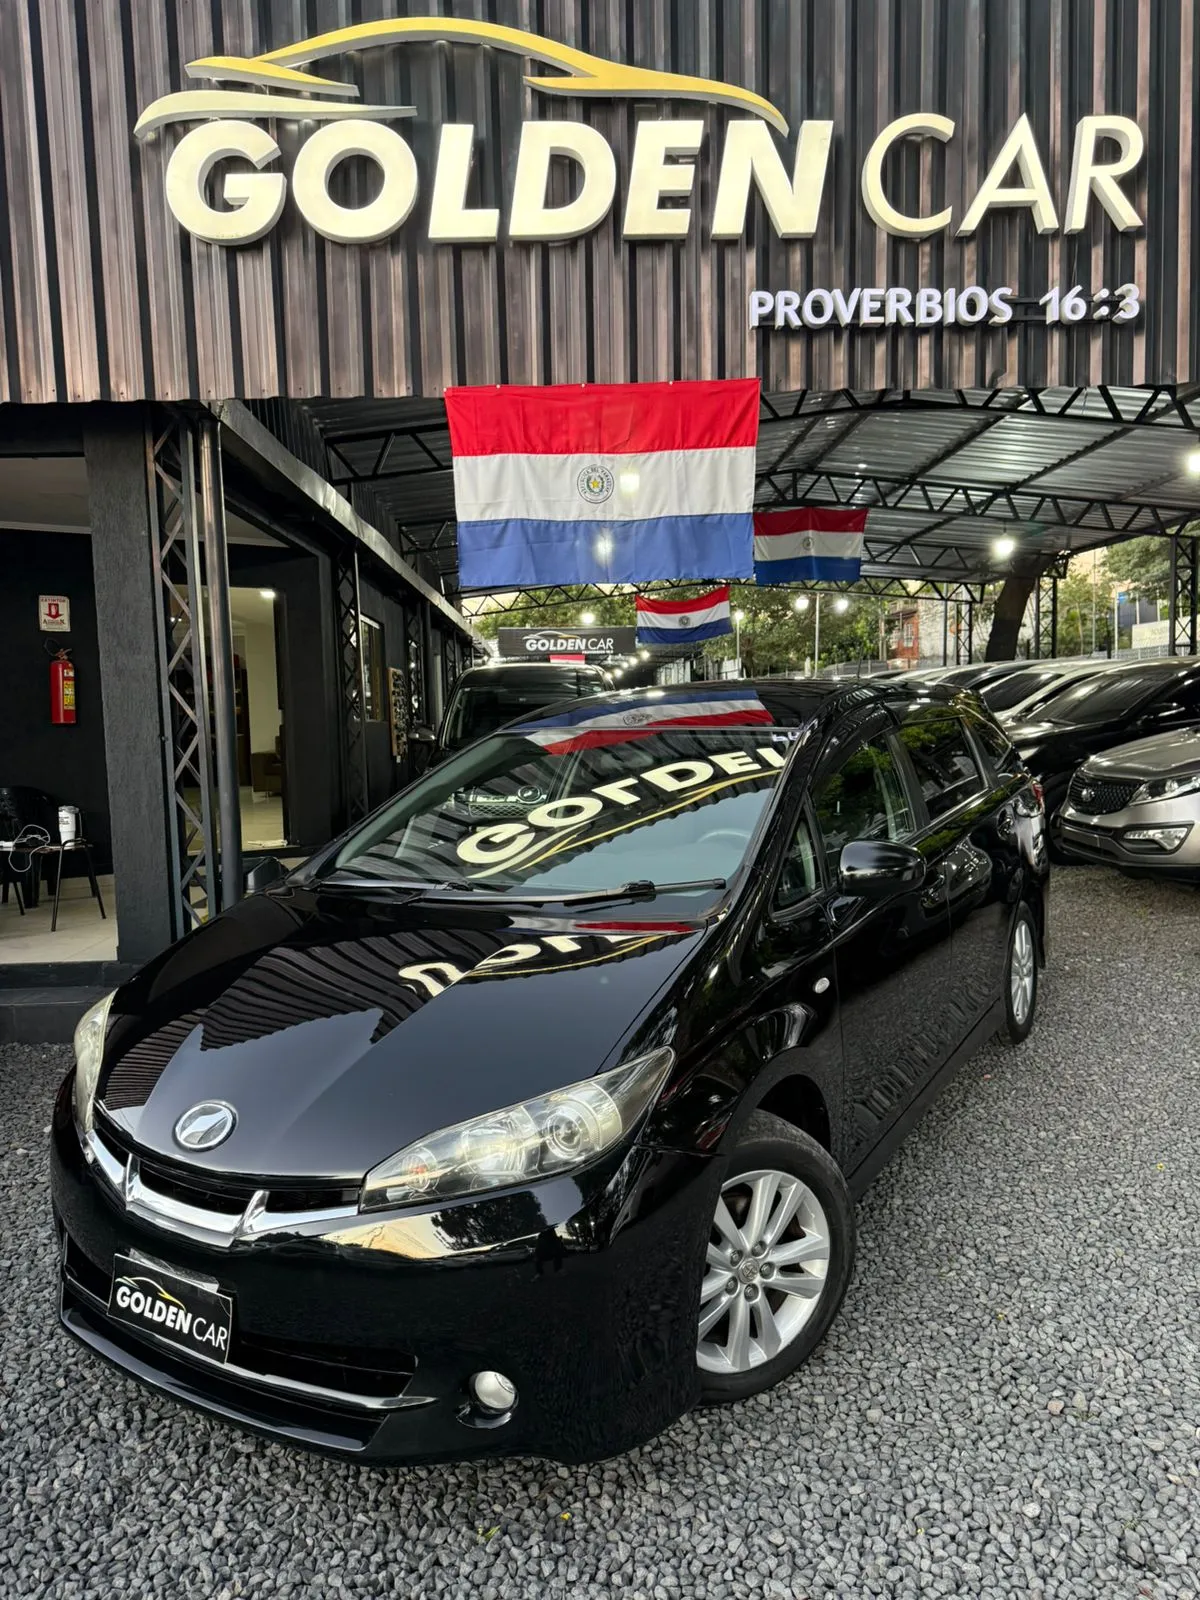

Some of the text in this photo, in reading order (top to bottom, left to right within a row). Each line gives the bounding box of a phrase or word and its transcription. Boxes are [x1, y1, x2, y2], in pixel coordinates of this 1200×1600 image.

[164, 112, 1145, 245] GOLDEN CAR
[749, 283, 1142, 329] PROVERBIOS 16:3
[525, 637, 614, 652] GOLDEN CAR
[116, 1286, 228, 1351] GOLDEN CAR
